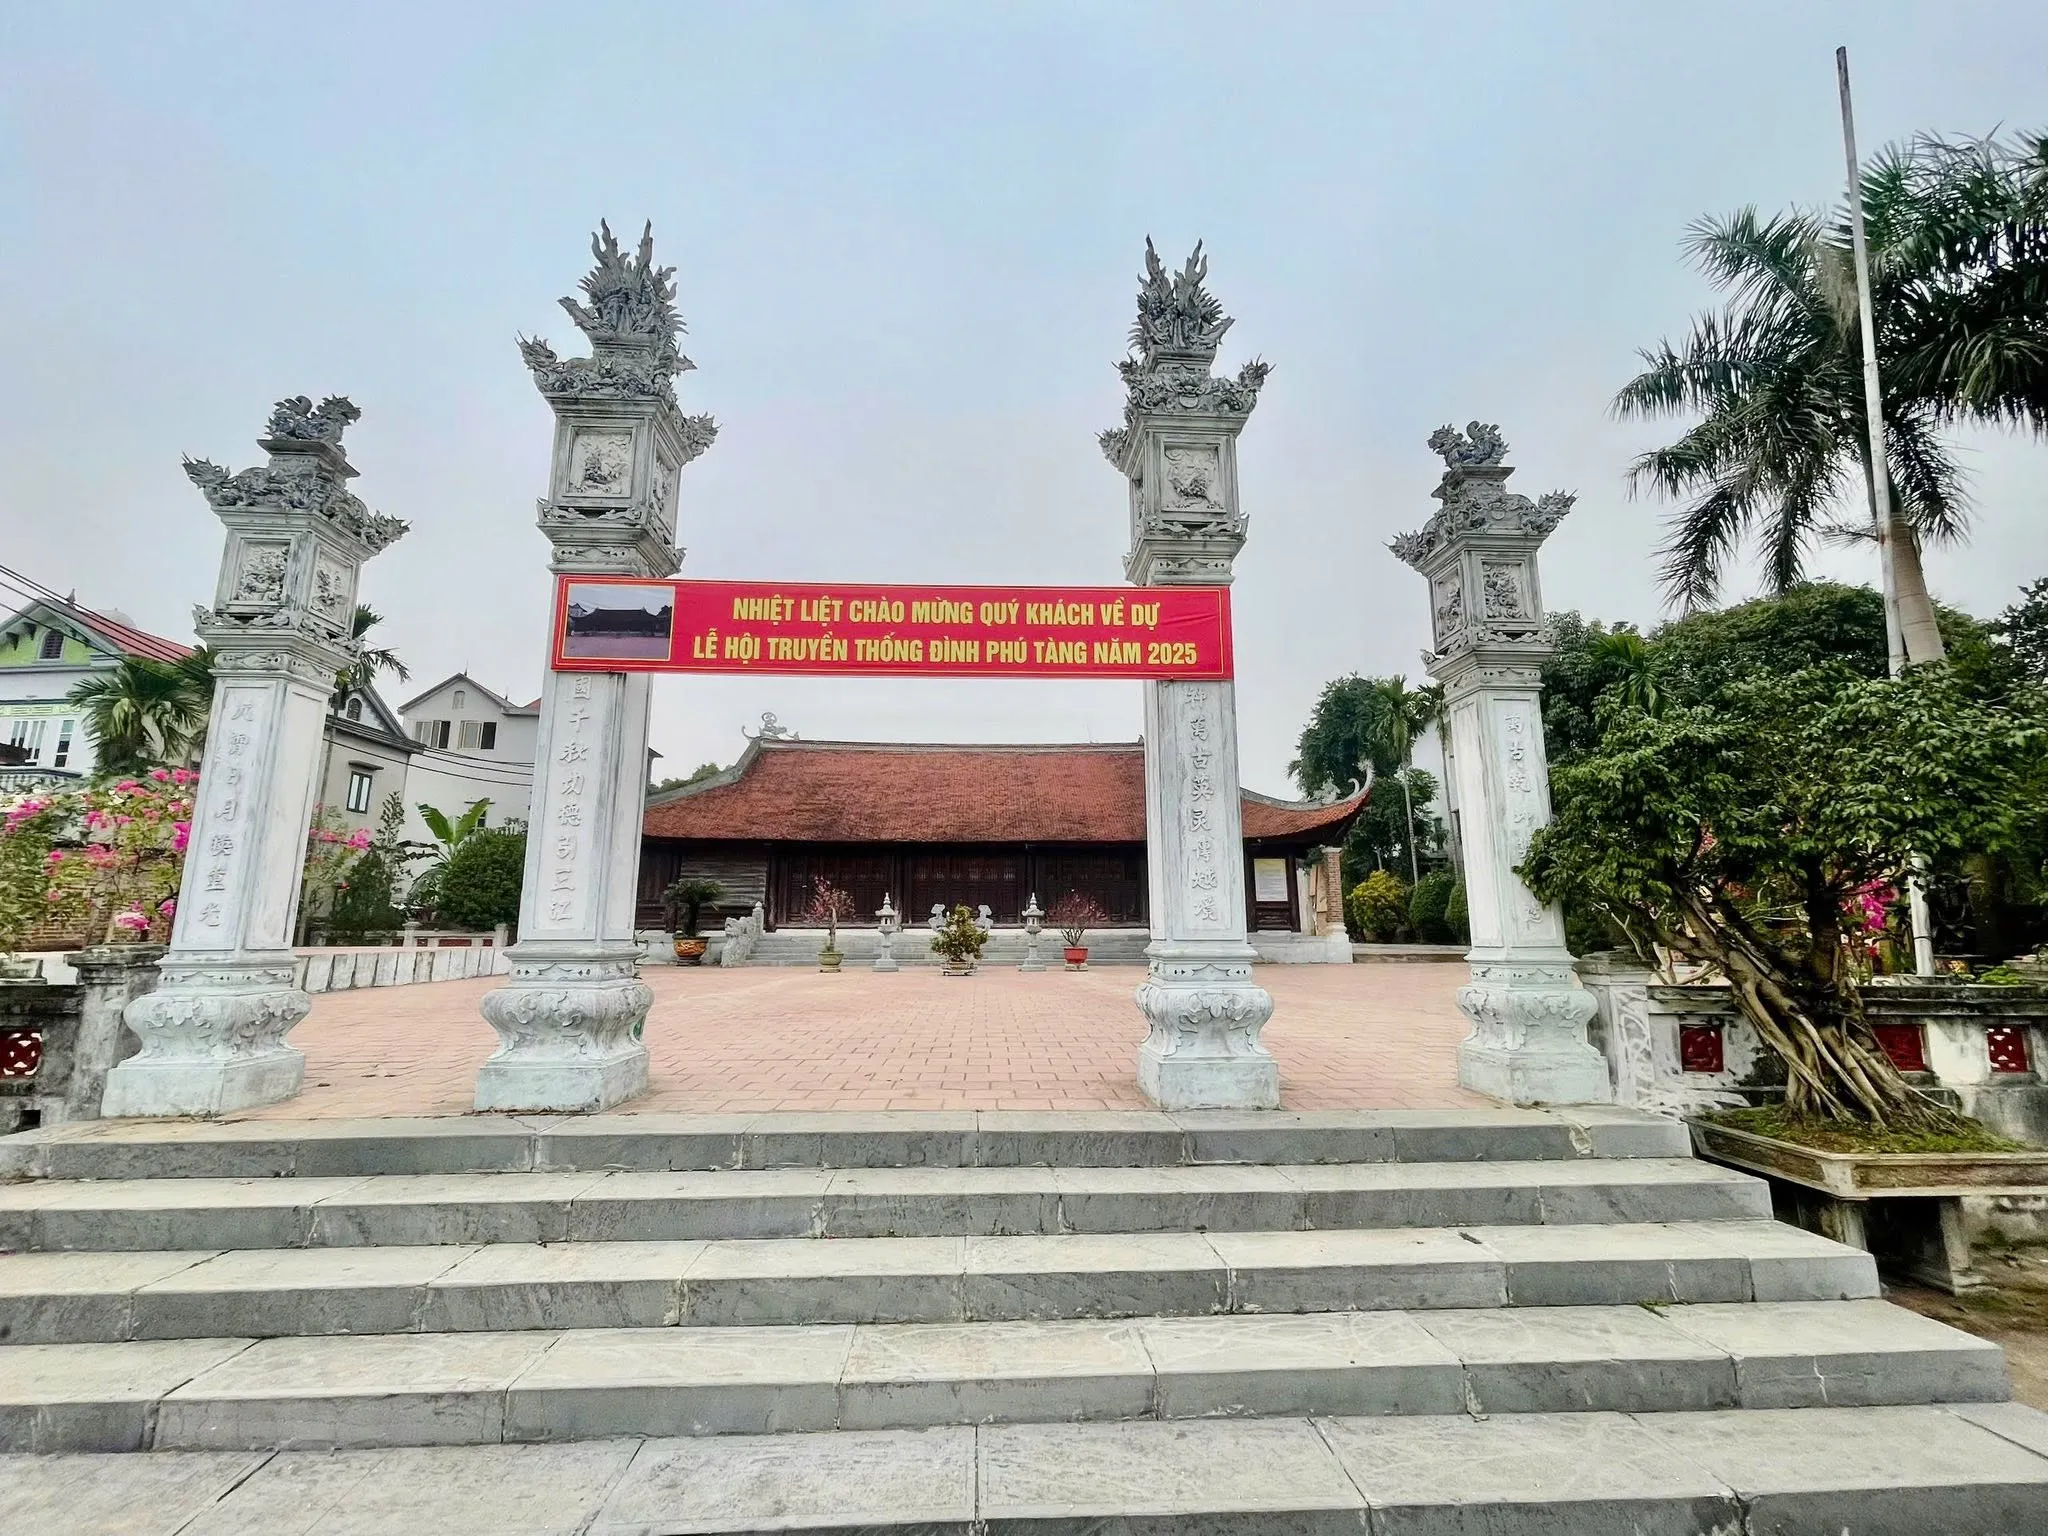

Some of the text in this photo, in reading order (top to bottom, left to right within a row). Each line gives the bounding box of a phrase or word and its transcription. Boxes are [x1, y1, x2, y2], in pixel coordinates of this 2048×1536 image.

[734, 594, 1160, 630] NHIỆT LIỆT CHÀO MỪNG QUÝ KHÁCH VỀ DỰ
[694, 628, 1196, 664] LỄ HỘI TRUYỀN THỐNG ĐÌNH PHÚ TÀNG NĂM 2025
